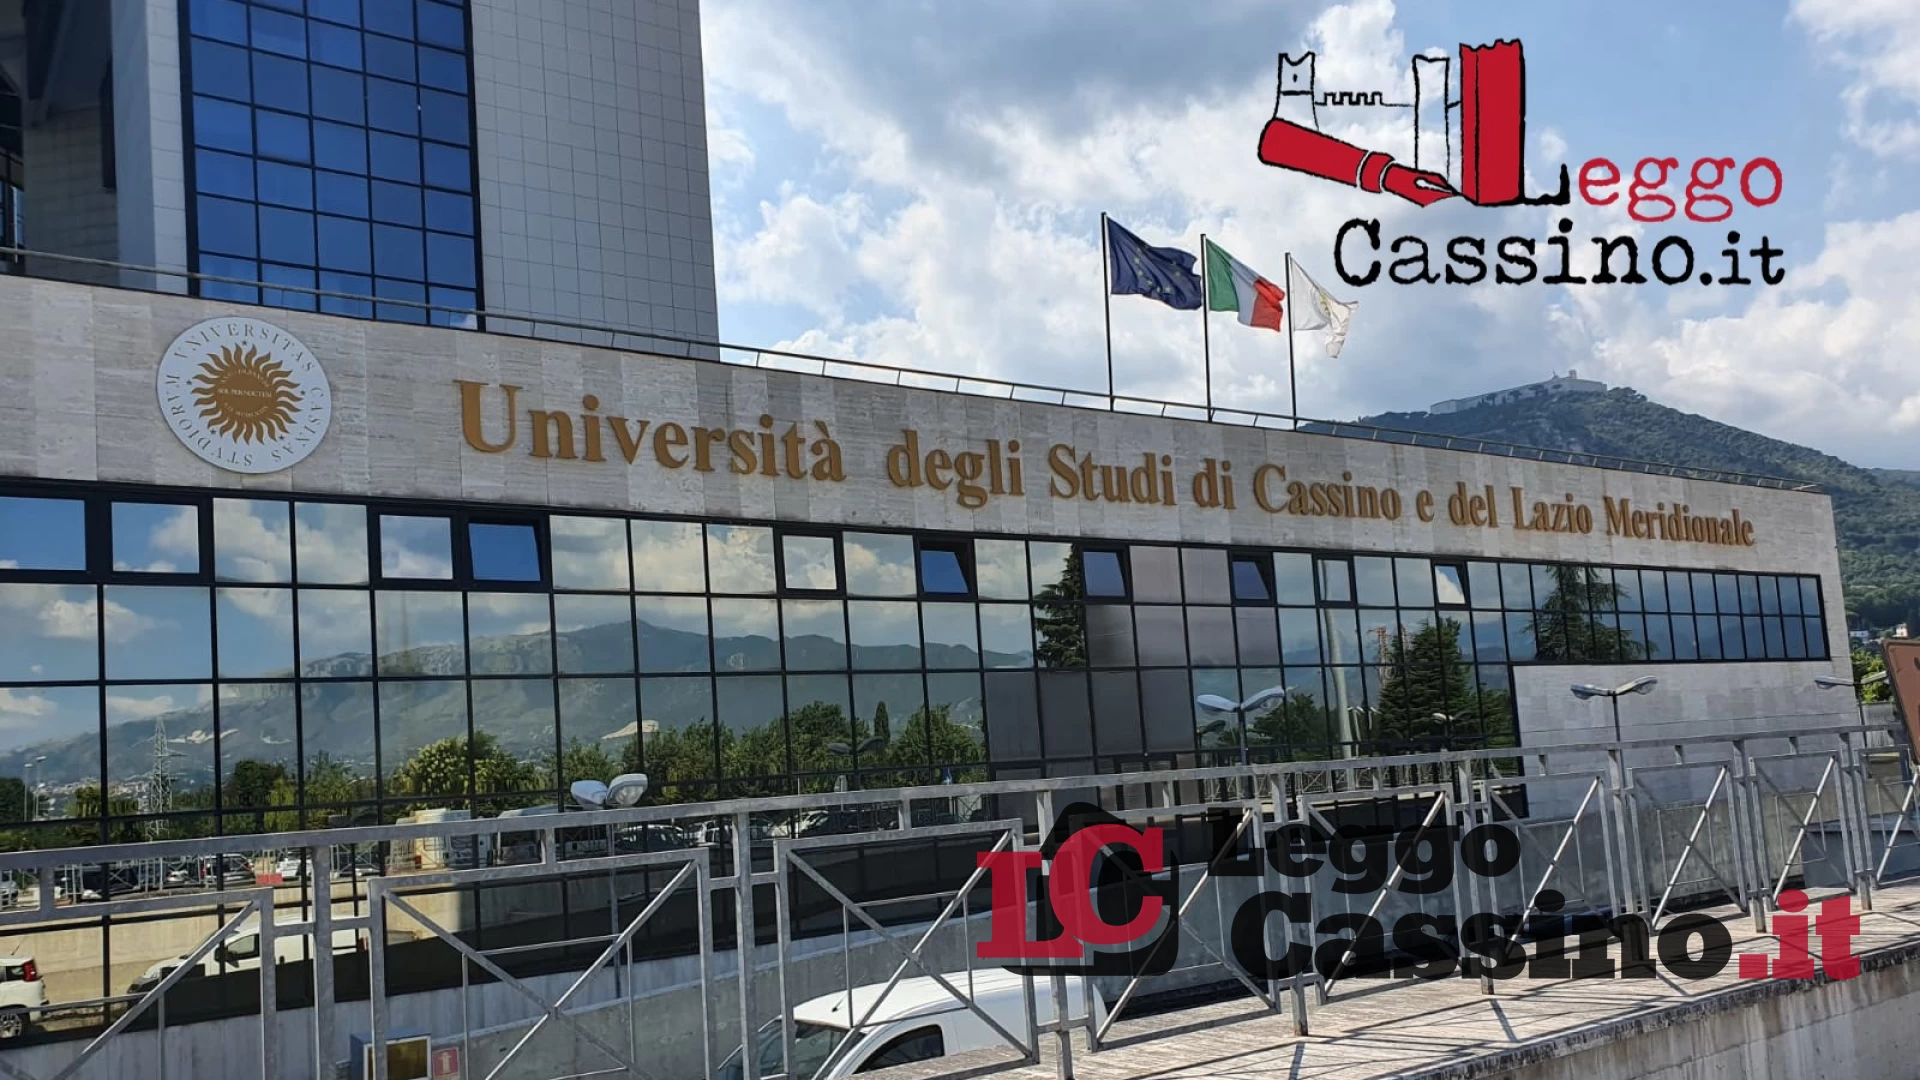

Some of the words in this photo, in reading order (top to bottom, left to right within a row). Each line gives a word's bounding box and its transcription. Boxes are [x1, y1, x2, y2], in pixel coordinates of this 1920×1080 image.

[270, 387, 324, 463] CASINAS
[452, 379, 846, 482] Università
[886, 429, 1025, 509] degli
[1048, 443, 1177, 507] Studi
[1192, 457, 1237, 510] di
[1253, 463, 1402, 521] Cassino
[1415, 488, 1435, 523] e
[1448, 481, 1499, 528] del
[1511, 485, 1594, 535] Lazio
[1603, 495, 1756, 547] Meridionale
